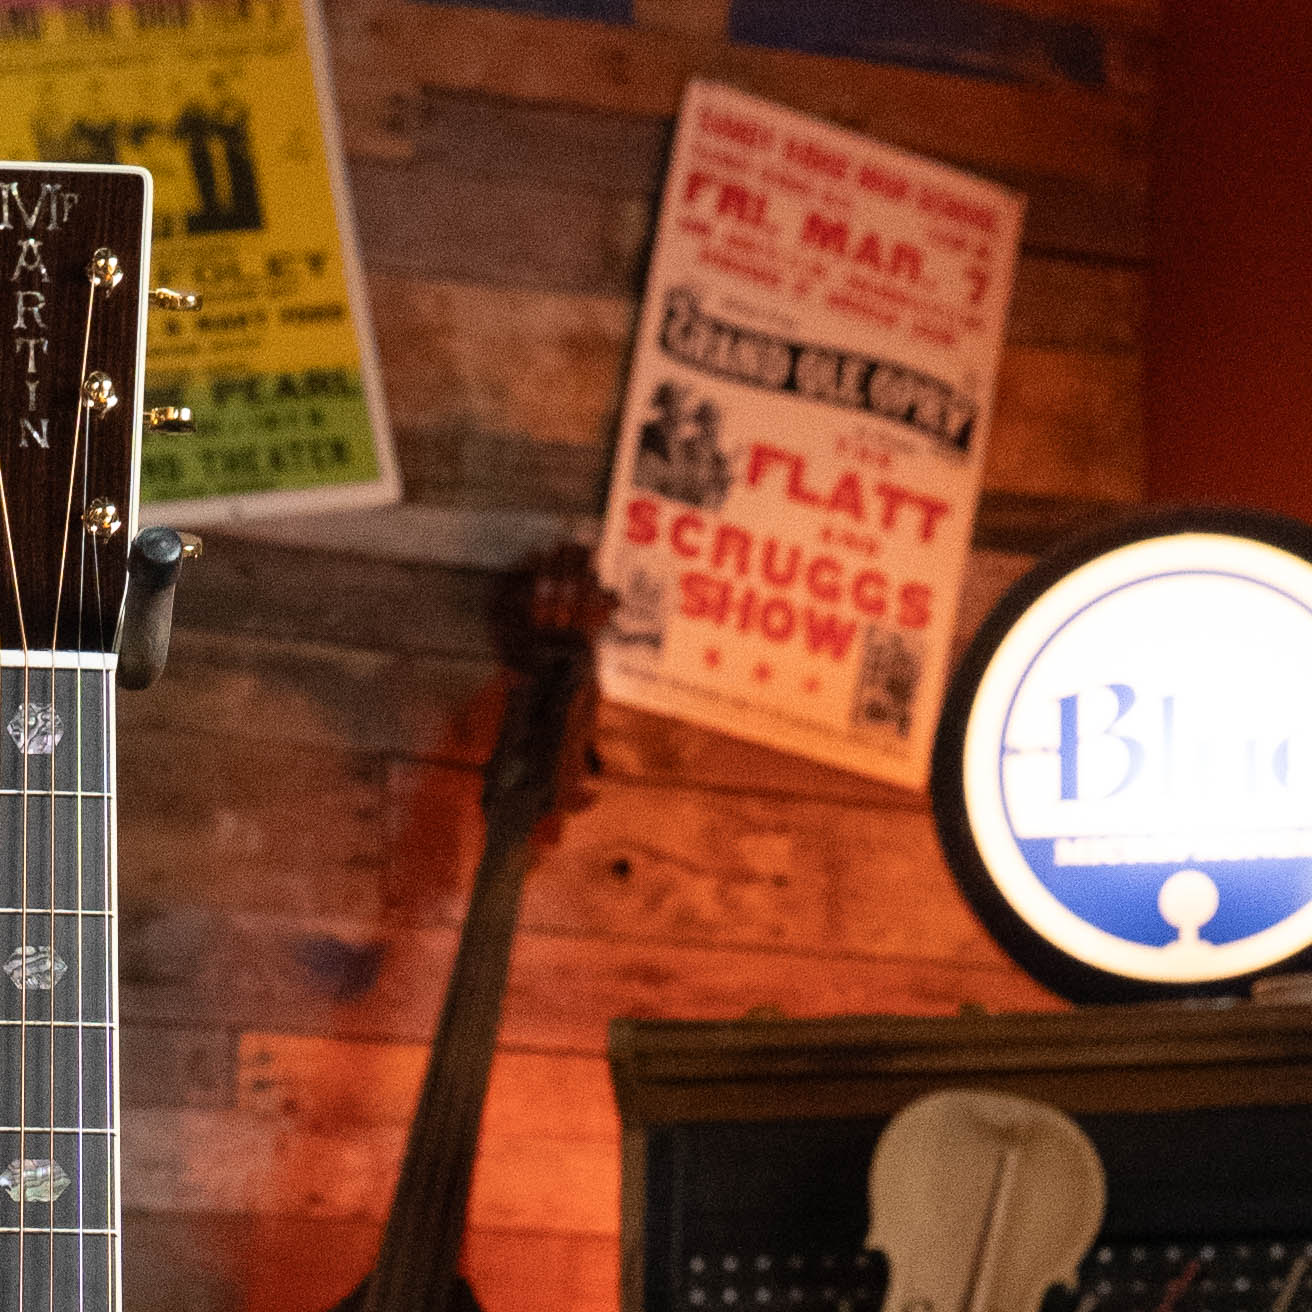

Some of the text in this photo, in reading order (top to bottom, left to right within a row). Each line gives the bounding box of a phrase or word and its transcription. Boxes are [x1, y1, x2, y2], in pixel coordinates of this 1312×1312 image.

[746, 442, 951, 545] FLATT
[626, 497, 933, 630] SCRUGGS
[680, 570, 858, 662] SHOW
